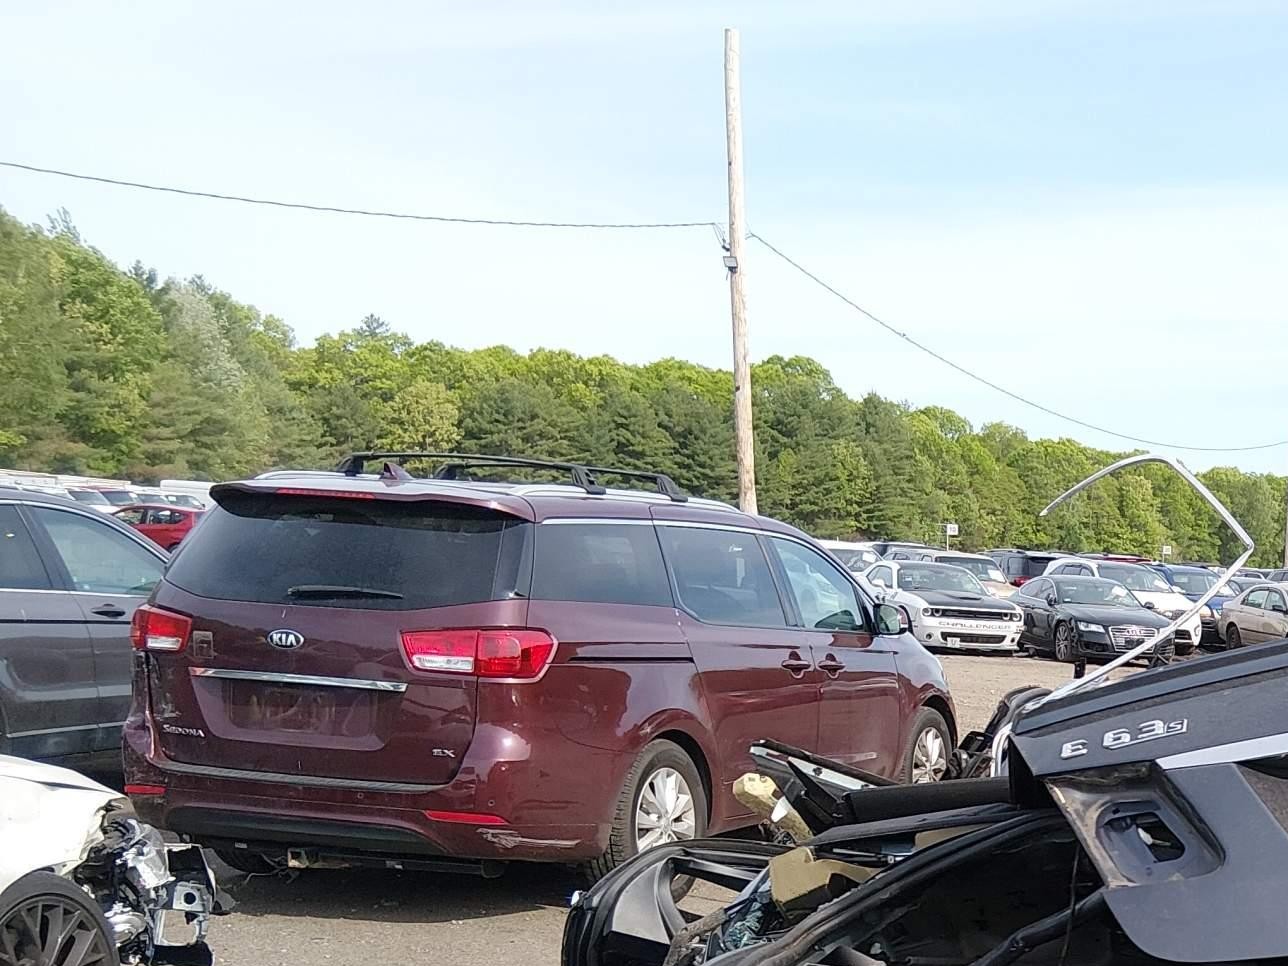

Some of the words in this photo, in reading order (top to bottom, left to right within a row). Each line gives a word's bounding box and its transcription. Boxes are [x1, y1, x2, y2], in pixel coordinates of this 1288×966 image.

[939, 621, 1011, 629] CHALLENGER
[272, 633, 297, 646] KIA
[431, 749, 456, 757] EX
[1060, 739, 1088, 759] E
